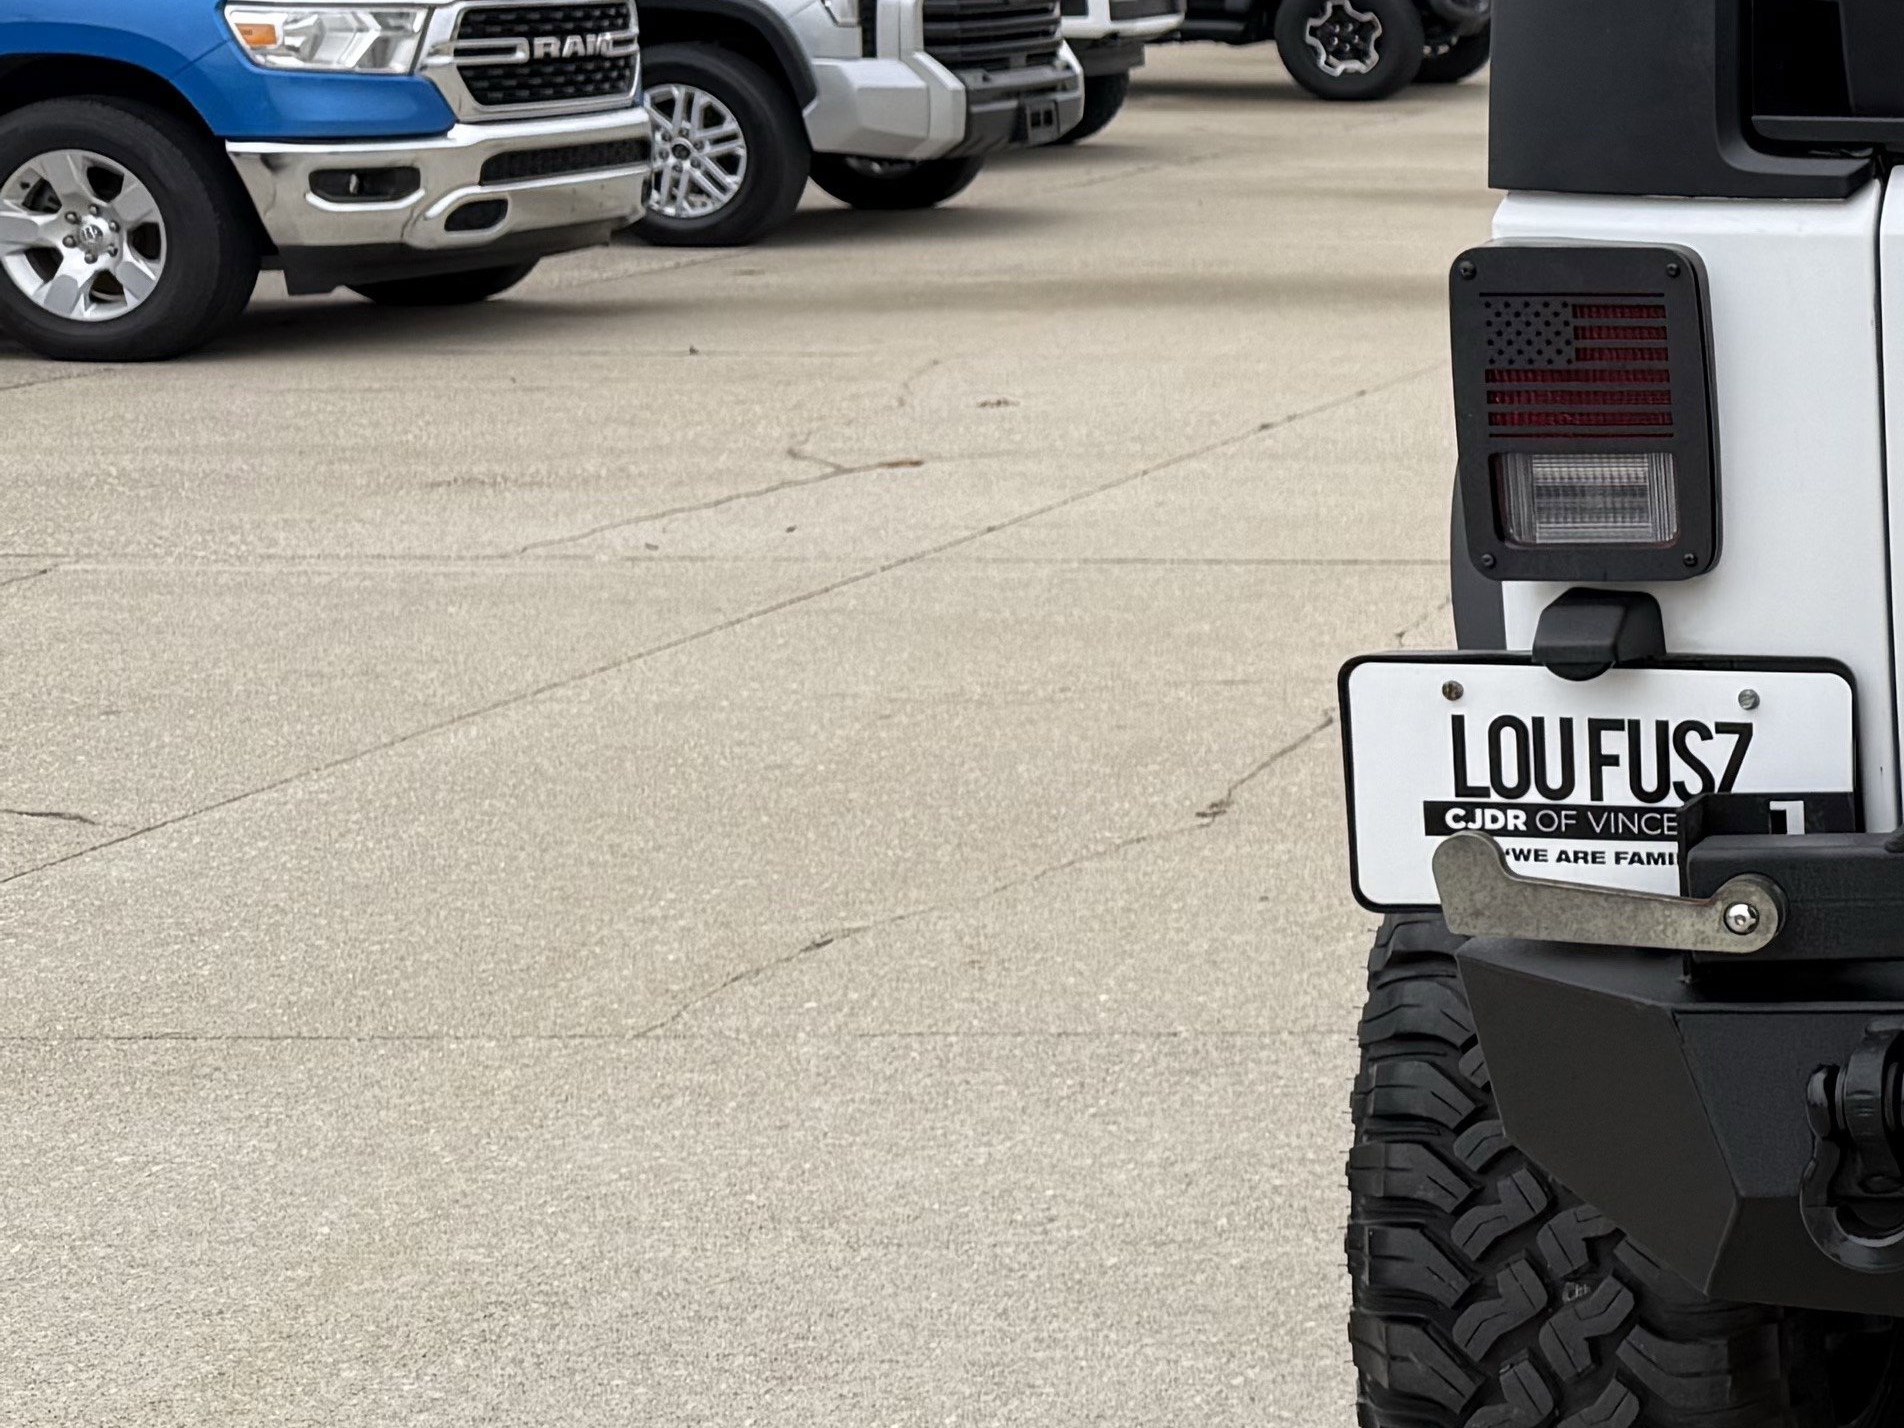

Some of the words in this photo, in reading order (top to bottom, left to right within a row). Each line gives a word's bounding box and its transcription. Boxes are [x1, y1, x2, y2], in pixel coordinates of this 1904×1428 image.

[1451, 714, 1576, 800] LOU
[1444, 807, 1528, 832] CJDR
[1535, 809, 1577, 833] OF
[1587, 811, 1680, 836] VINCE
[1556, 849, 1607, 865] ARE
[1614, 851, 1680, 867] FAMI
